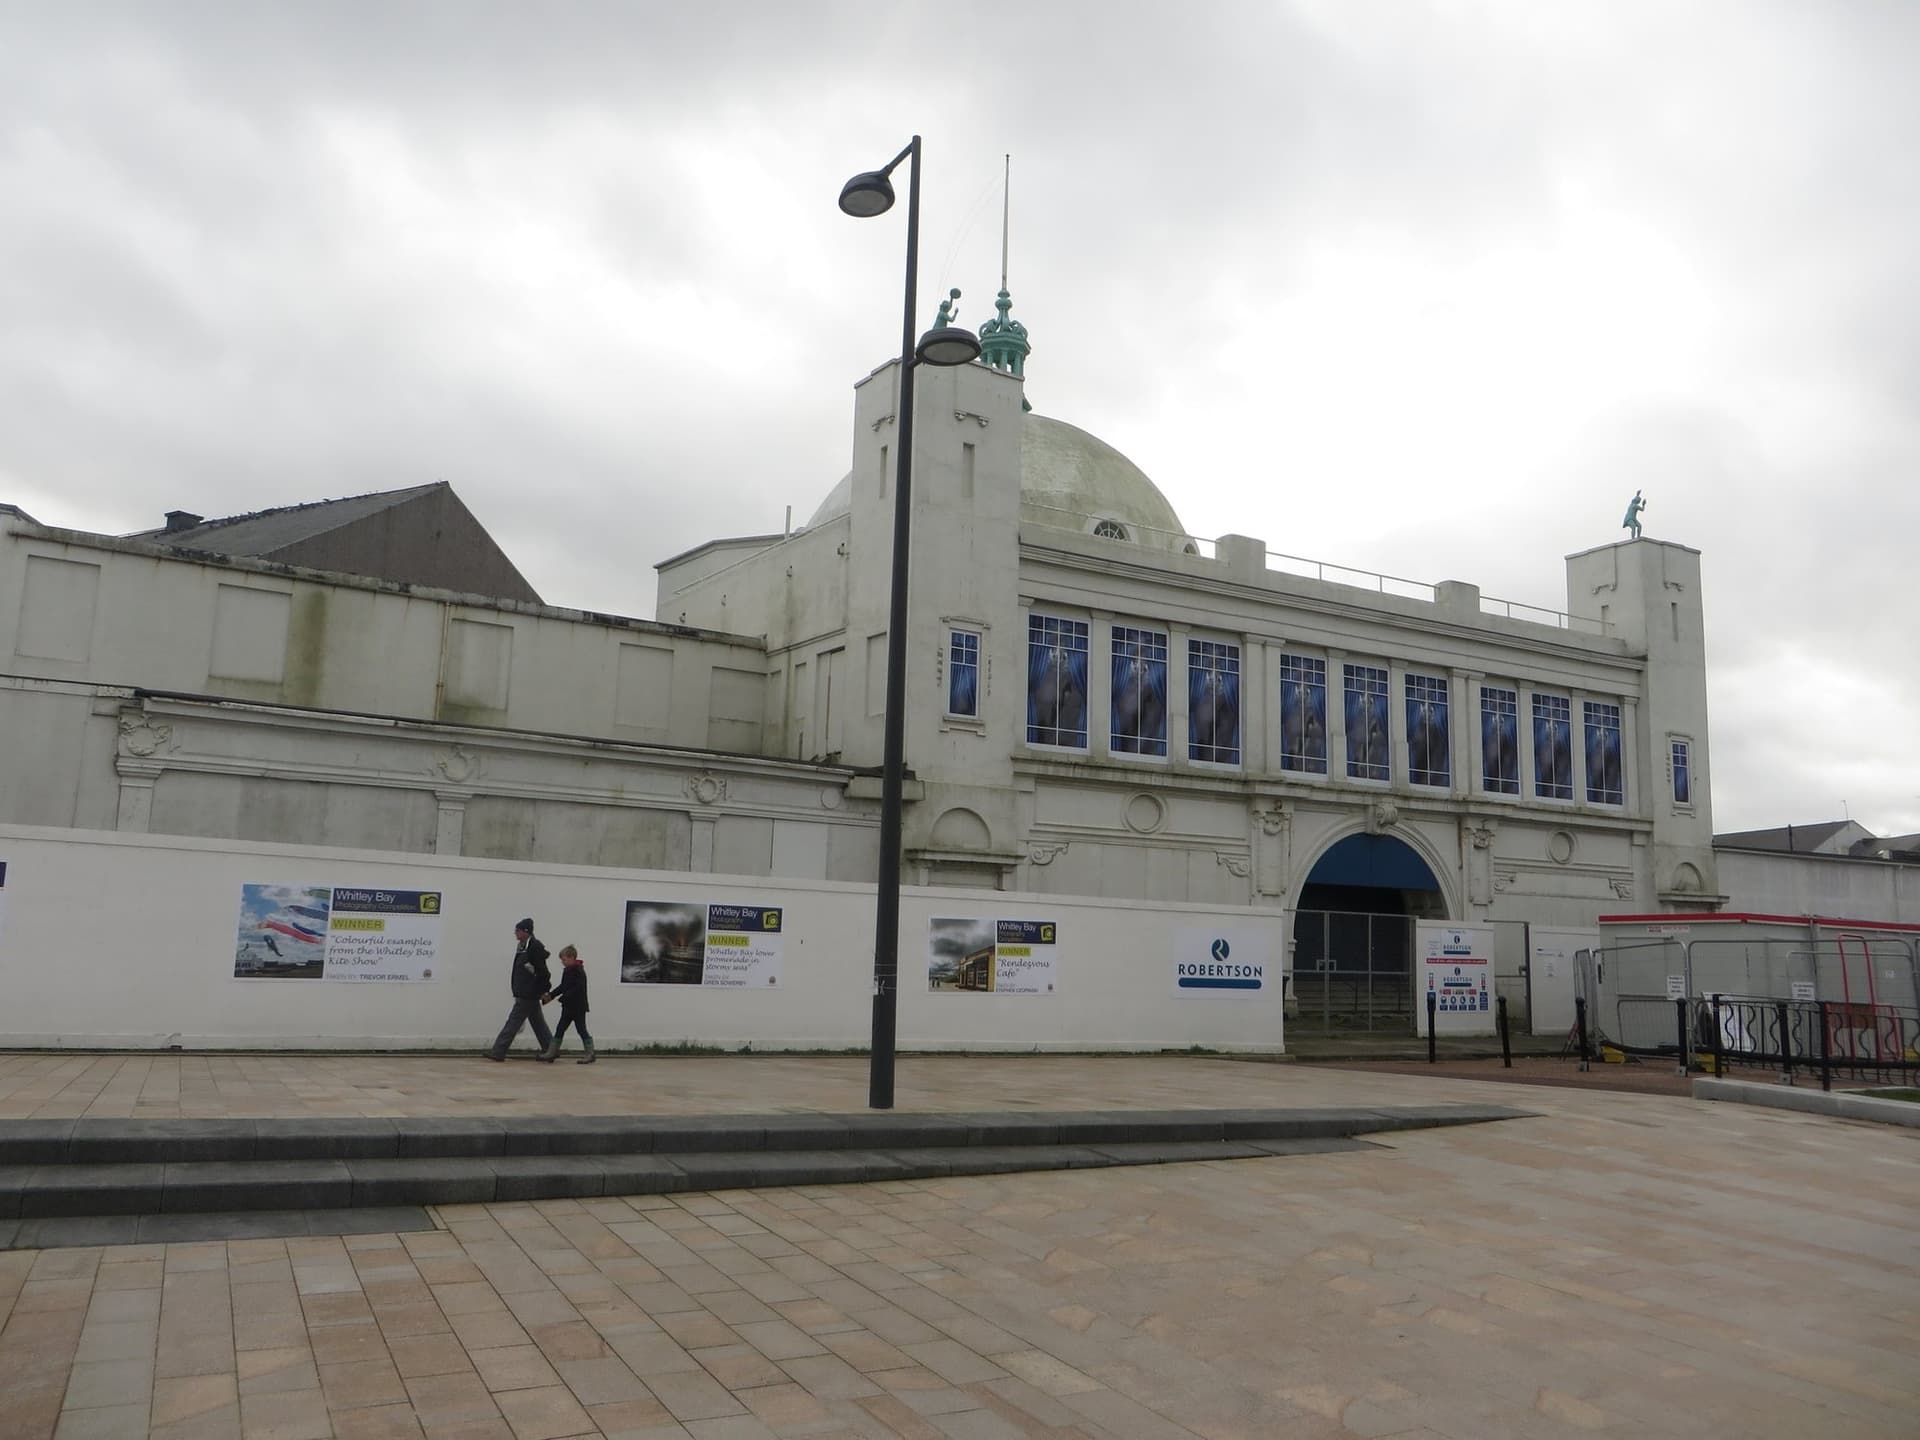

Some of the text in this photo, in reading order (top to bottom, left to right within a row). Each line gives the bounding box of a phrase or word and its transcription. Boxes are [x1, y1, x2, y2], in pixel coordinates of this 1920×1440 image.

[336, 890, 396, 903] Whitley Bay
[711, 906, 758, 919] Whitley Bay
[333, 919, 383, 929] WINNER
[998, 921, 1022, 932] Whitley
[386, 937, 432, 948] examples
[709, 935, 749, 945] WINNER
[329, 945, 435, 958] from the Whitley Bay
[328, 957, 350, 965] Kite
[1178, 963, 1262, 977] ROBERTSON
